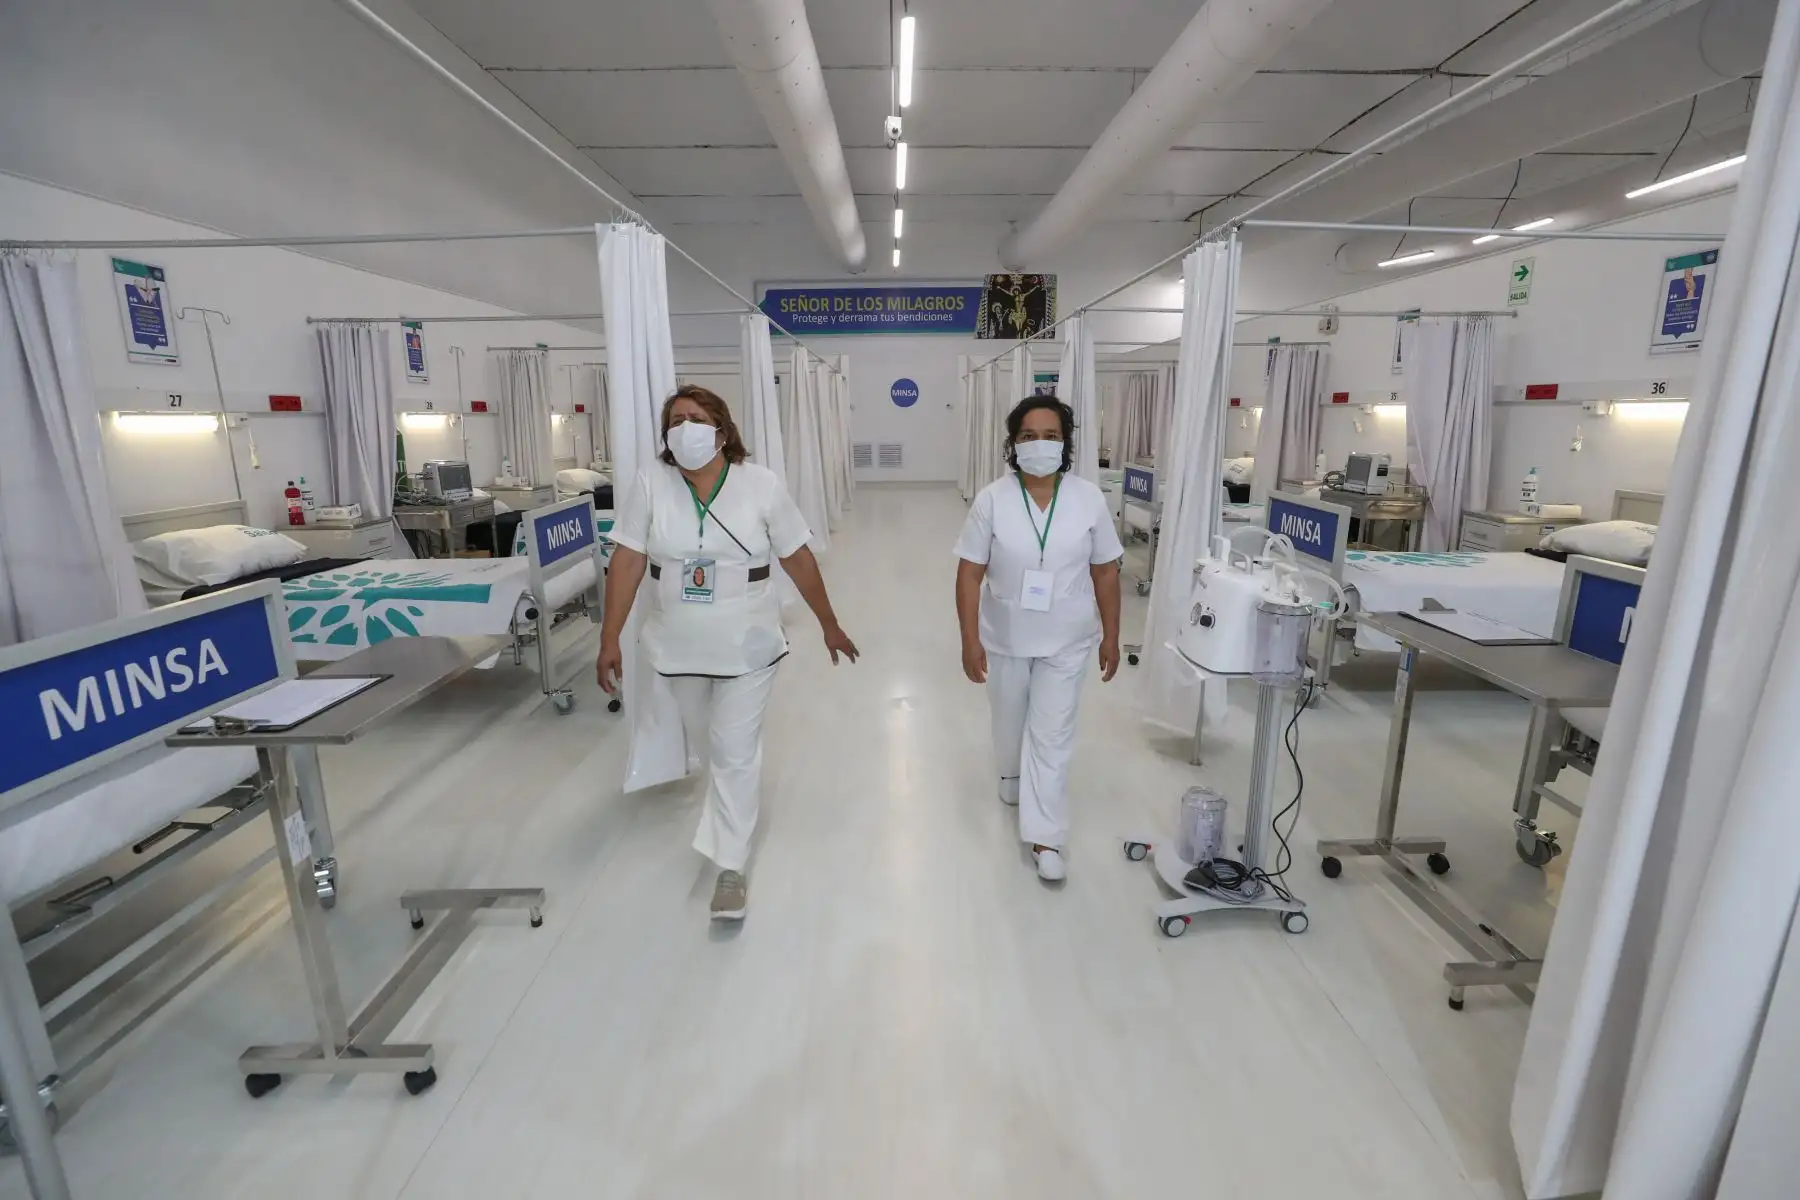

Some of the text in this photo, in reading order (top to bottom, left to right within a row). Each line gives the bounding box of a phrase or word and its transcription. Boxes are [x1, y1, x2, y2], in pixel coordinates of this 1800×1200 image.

[780, 294, 964, 312] SEÑOR DE LOS MILAGROS
[792, 312, 953, 324] Protege y derrama tus bendiciones
[891, 389, 917, 397] MINSA
[1651, 382, 1666, 395] 36
[169, 394, 182, 407] 27
[1390, 392, 1398, 401] 35
[1130, 475, 1148, 494] MINSA
[546, 517, 583, 550] MINSA
[1280, 512, 1321, 546] MINSA
[39, 638, 229, 740] MINSA
